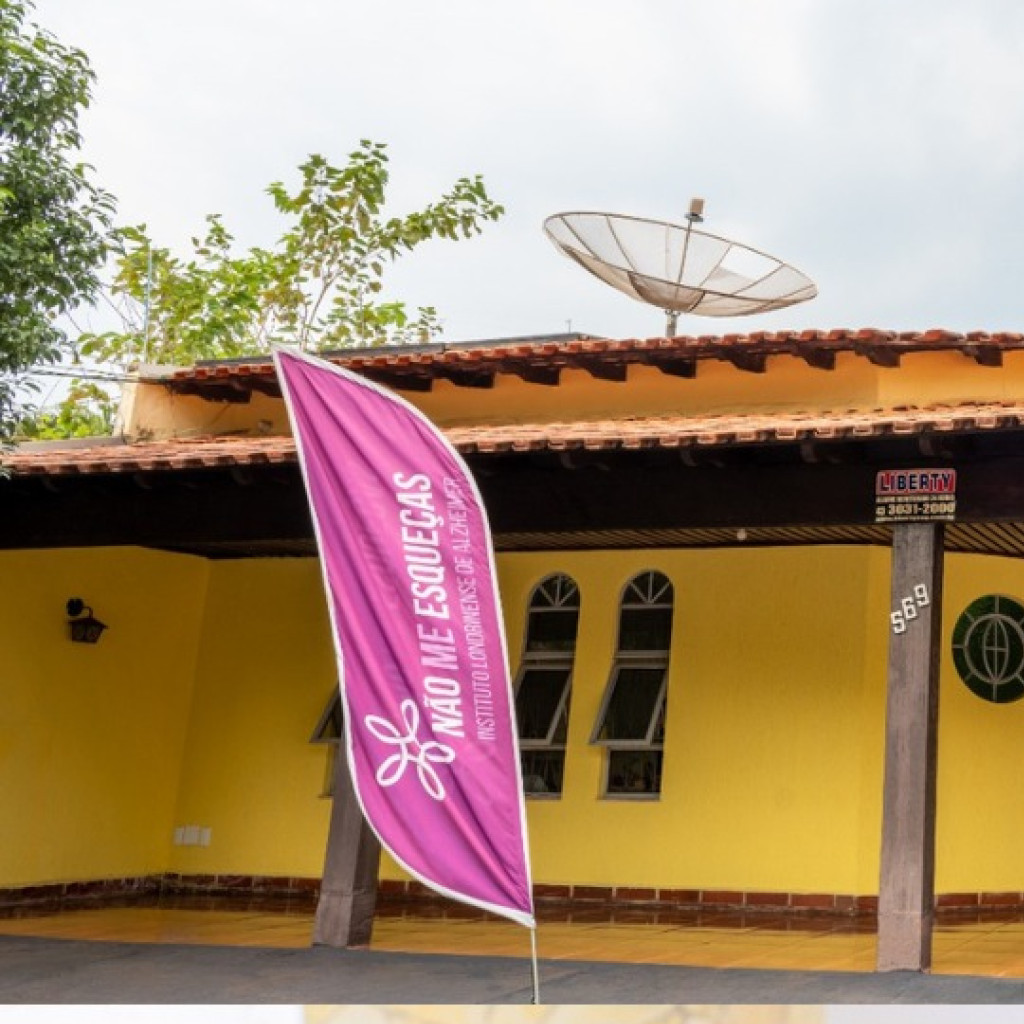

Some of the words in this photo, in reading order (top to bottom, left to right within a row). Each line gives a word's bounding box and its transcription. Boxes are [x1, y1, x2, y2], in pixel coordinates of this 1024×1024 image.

[880, 473, 951, 491] LIBERTY
[393, 471, 450, 619] ESQUEÇAS
[454, 556, 475, 574] DE
[457, 576, 488, 668] LONDRINENSE
[890, 583, 930, 634] 569
[417, 623, 459, 670] ME
[423, 676, 465, 738] NÃO
[472, 670, 496, 740] INSTITUTO
